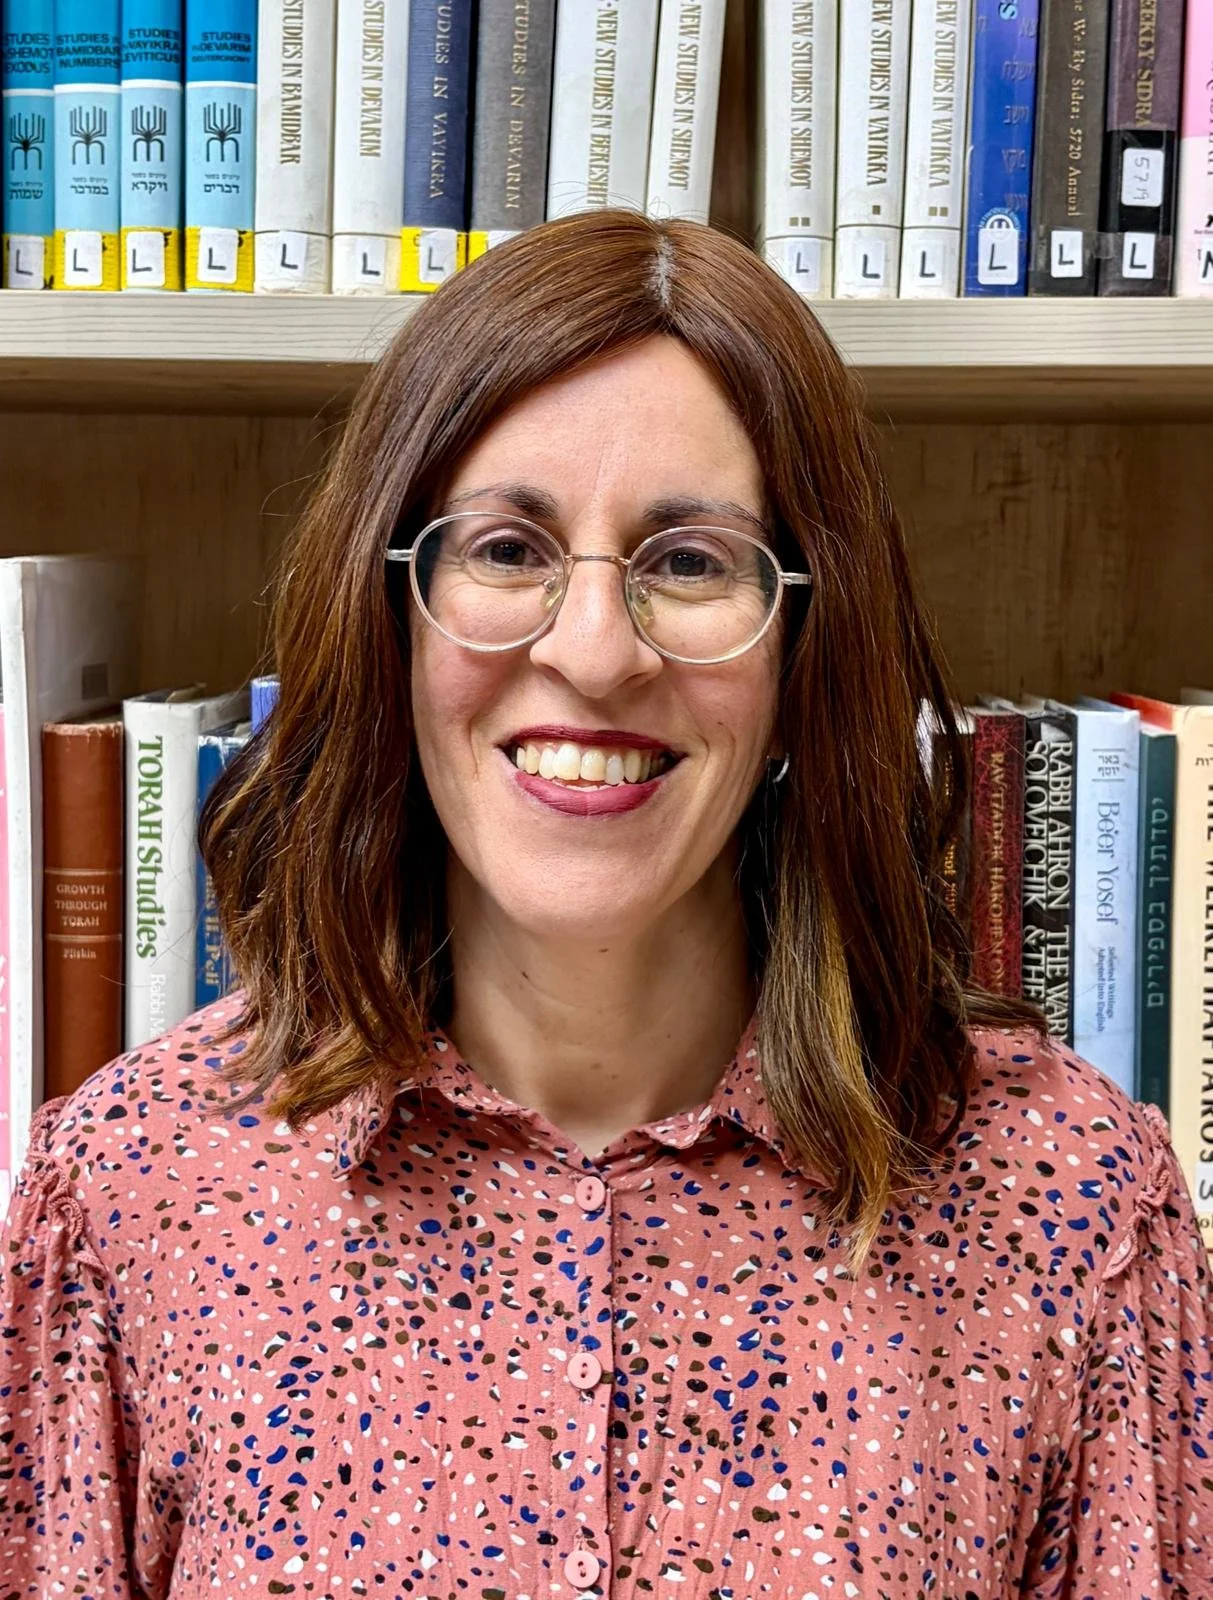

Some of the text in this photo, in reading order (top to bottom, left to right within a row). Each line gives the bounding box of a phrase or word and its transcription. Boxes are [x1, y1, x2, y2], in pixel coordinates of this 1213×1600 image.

[56, 33, 110, 45] STUDIES
[128, 28, 181, 39] STUDIES
[201, 31, 252, 43] STUDIES
[596, 8, 618, 46] NEW
[121, 51, 181, 64] LEVITICUS
[127, 40, 181, 51] VAYIKRA
[59, 57, 121, 69] NUMBERS
[869, 29, 893, 93] STUDIES
[933, 29, 957, 93] STUDIES
[280, 0, 304, 165] STUDIES IN BAMIDBAR
[359, 0, 385, 158] STUDIES IN DEVARIM
[592, 48, 616, 111] STUDIES
[429, 0, 452, 199] UDIES IN VAYIKRA
[511, 86, 525, 108] IN
[668, 3, 702, 191] NEW STUDIES IN SHEMOT
[789, 1, 813, 190] NEW STUDIES IN SHEMOT
[869, 95, 891, 112] IN
[932, 96, 955, 113] IN
[1134, 67, 1155, 128] SIDRA
[591, 114, 613, 130] IN
[866, 116, 891, 187] VAYIKRA
[929, 117, 953, 188] VAYIKRA
[1068, 127, 1083, 160] 5720
[504, 119, 524, 209] DEVARIM
[9, 188, 44, 200] שמות
[70, 184, 109, 196] במדבר
[131, 181, 168, 195] ויקרא
[203, 183, 240, 195] דברים
[1066, 166, 1083, 217] Annual
[16, 249, 33, 276] L
[73, 249, 88, 272] L
[132, 249, 153, 272] L
[207, 247, 226, 270] L
[280, 243, 299, 270] L
[361, 252, 380, 276] L
[427, 246, 444, 272] L
[796, 252, 809, 273] L
[862, 254, 880, 279] L
[919, 251, 936, 278] L
[988, 243, 1007, 270] L
[1058, 243, 1075, 266] L
[1129, 242, 1147, 270] L
[1097, 766, 1120, 777] יוסף
[1098, 754, 1120, 764] באר
[1047, 740, 1073, 910] RABBI AHRON
[136, 735, 168, 960] TORAH Studies
[56, 884, 105, 896] GROWTH
[1096, 866, 1120, 925] Yosef
[1146, 797, 1170, 1008] יסדתיך בספירים
[55, 899, 108, 911] THROUGH
[61, 915, 100, 928] TORAH
[1022, 924, 1046, 999] & THE
[1047, 924, 1070, 979] THE
[150, 973, 167, 1014] Rabbi
